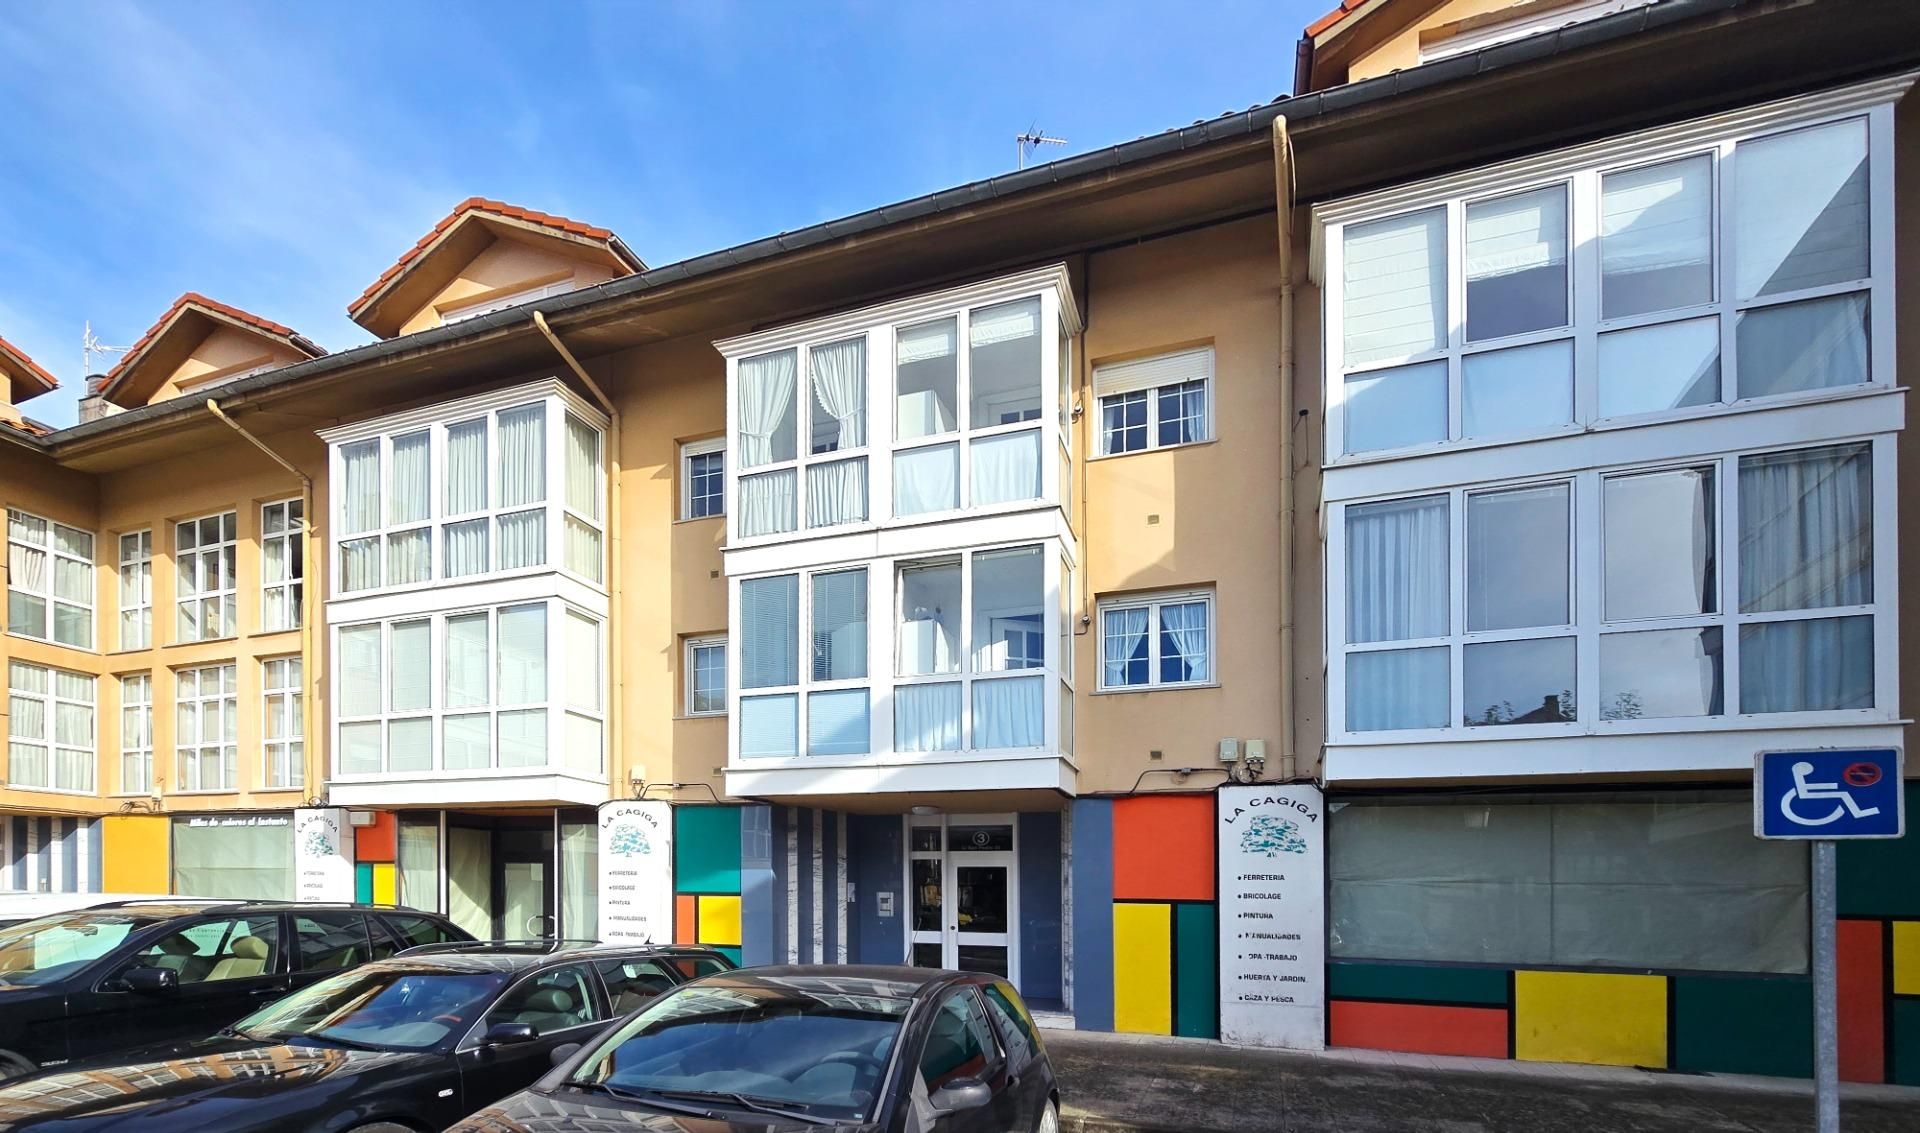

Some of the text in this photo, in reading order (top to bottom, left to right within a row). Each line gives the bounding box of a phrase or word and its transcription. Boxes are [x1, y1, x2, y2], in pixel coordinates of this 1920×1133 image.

[1224, 796, 1319, 824] LA CAGIGA
[296, 815, 338, 833] LA CAGIGA
[602, 808, 658, 829] LA CAGIGA
[1243, 892, 1282, 900] BRICOLAGE
[1243, 912, 1274, 920] PINTURA
[1243, 973, 1271, 982] HUERTA
[1280, 975, 1306, 983] JARDIN
